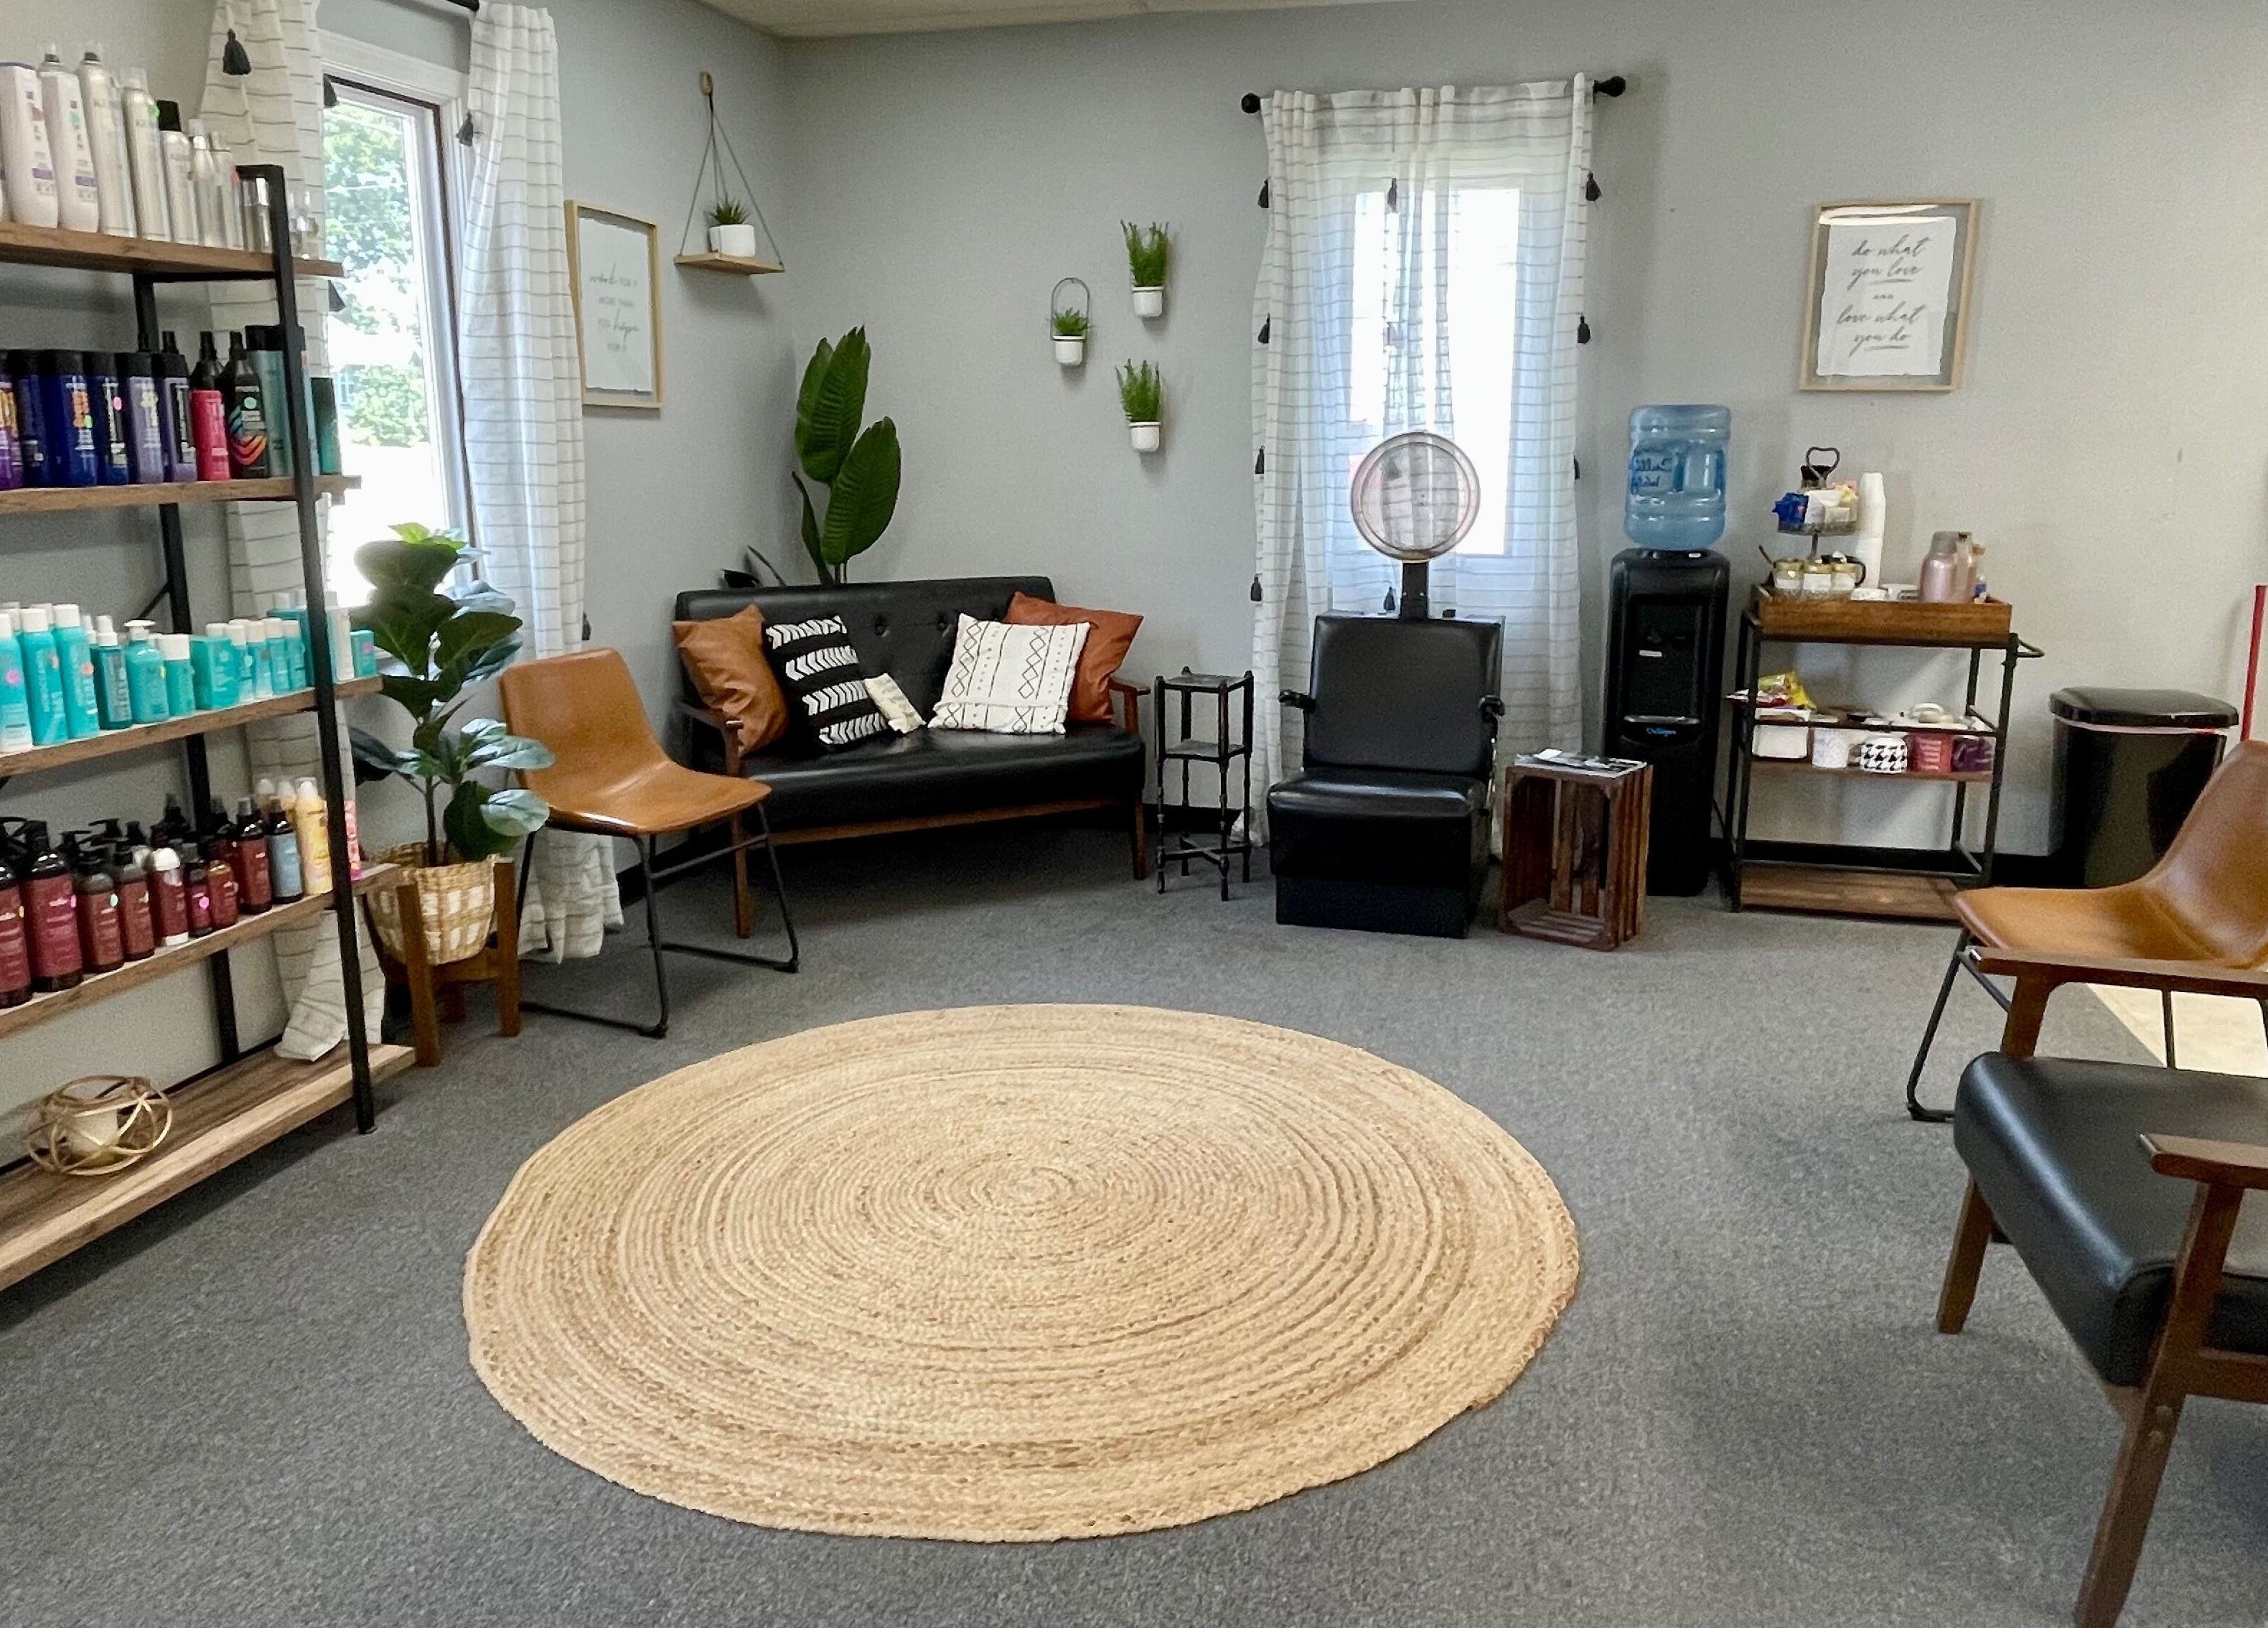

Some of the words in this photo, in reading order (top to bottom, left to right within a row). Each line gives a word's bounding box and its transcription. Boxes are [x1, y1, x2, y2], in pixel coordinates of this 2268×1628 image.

[1878, 233, 1931, 257] what
[1847, 268, 1882, 291] you
[1886, 256, 1923, 277] love
[1836, 304, 1870, 324] love
[1874, 301, 1927, 324] what
[1849, 334, 1885, 357] you
